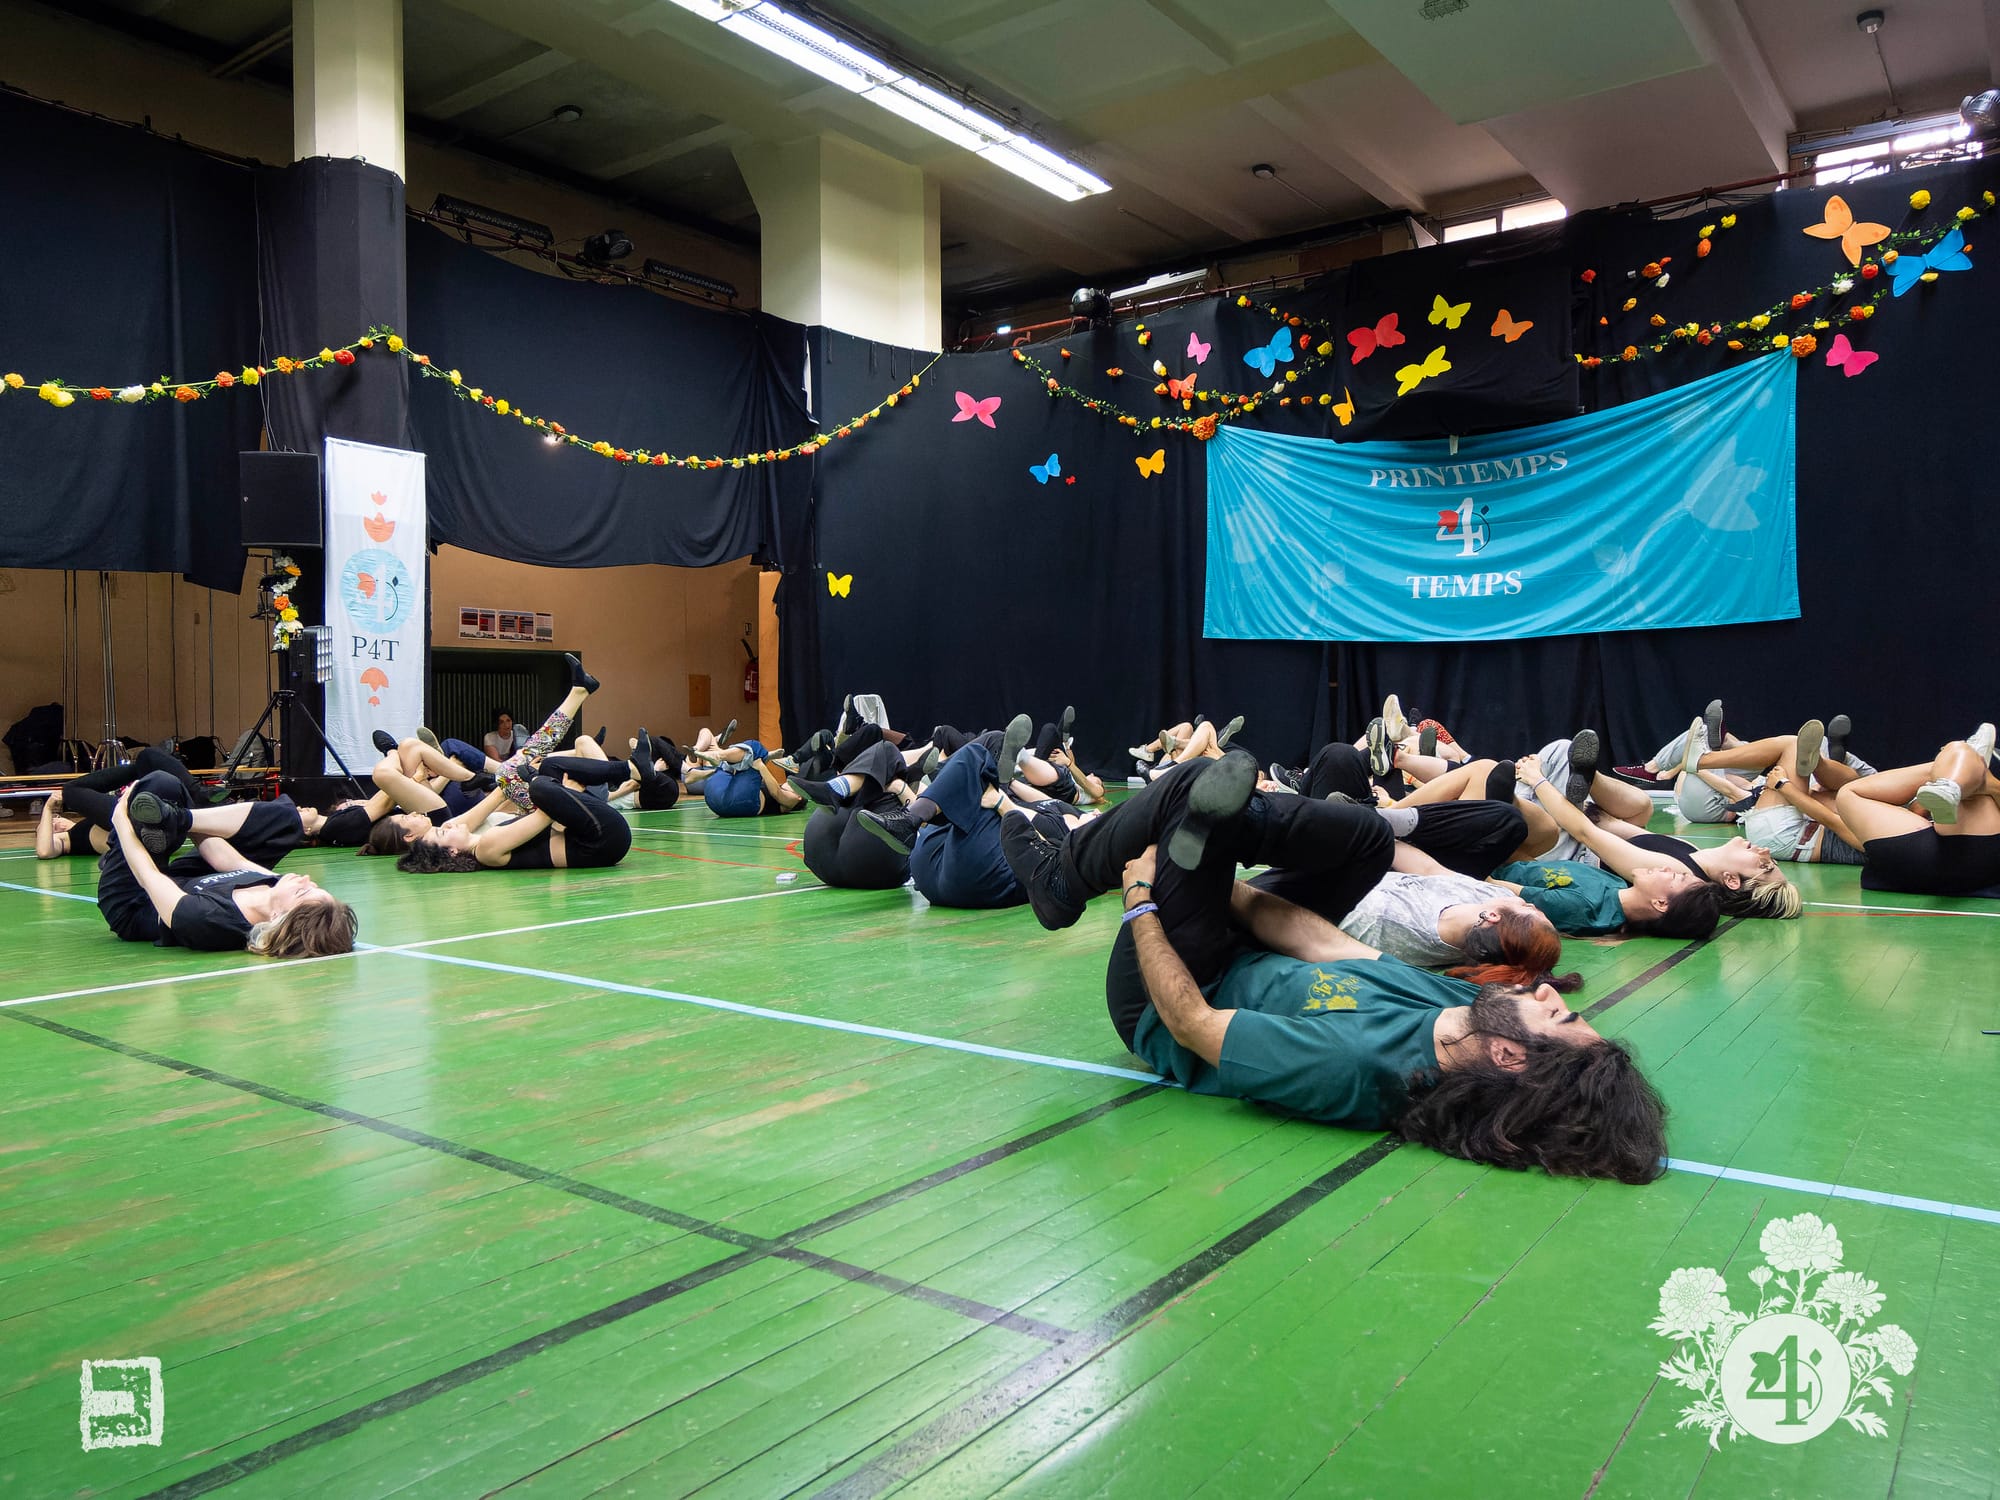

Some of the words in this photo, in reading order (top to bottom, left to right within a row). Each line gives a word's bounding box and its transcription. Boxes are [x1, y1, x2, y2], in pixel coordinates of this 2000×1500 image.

[1368, 450, 1568, 488] PRINTEMPS
[1436, 497, 1484, 557] 4
[1406, 570, 1522, 599] TEMPS
[352, 636, 400, 662] P4T
